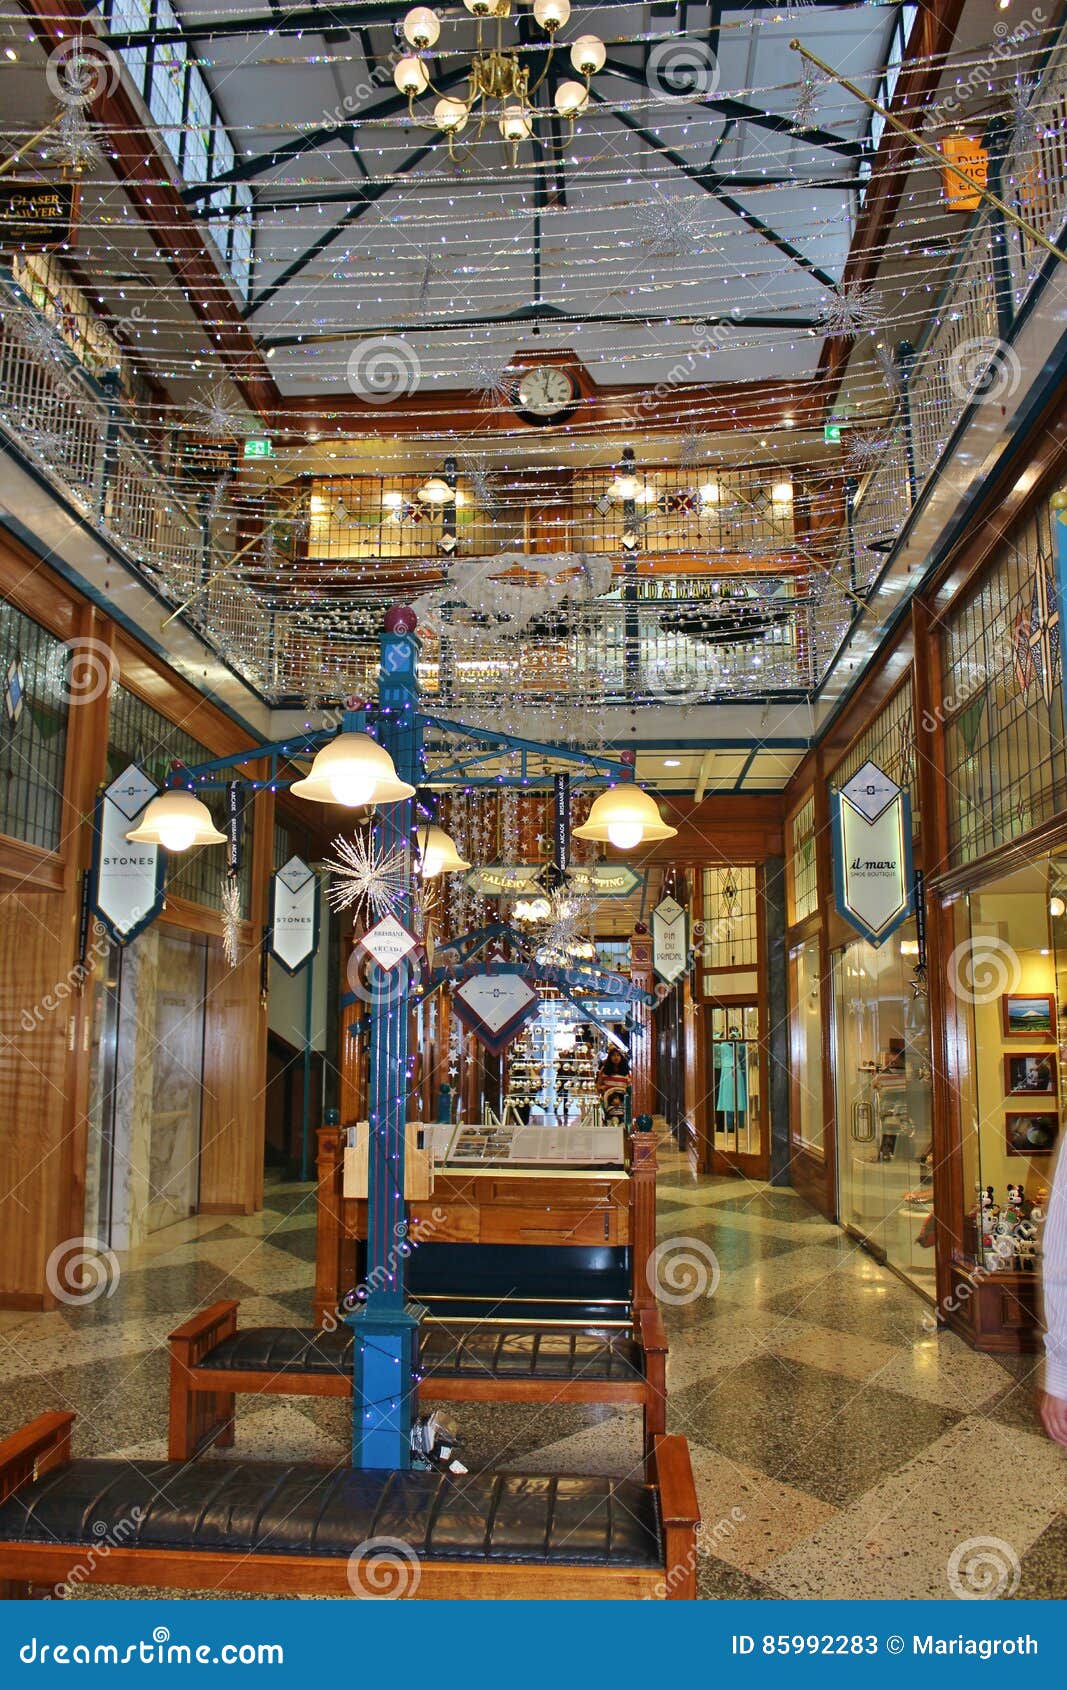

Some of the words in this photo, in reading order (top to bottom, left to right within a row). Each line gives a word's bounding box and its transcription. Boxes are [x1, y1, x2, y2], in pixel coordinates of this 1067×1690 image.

[10, 194, 60, 205] GLASER
[4, 206, 64, 218] LAWYERS
[103, 857, 154, 865] STONES
[850, 858, 861, 869] il
[861, 861, 896, 869] mare
[575, 873, 625, 888] SHPPING
